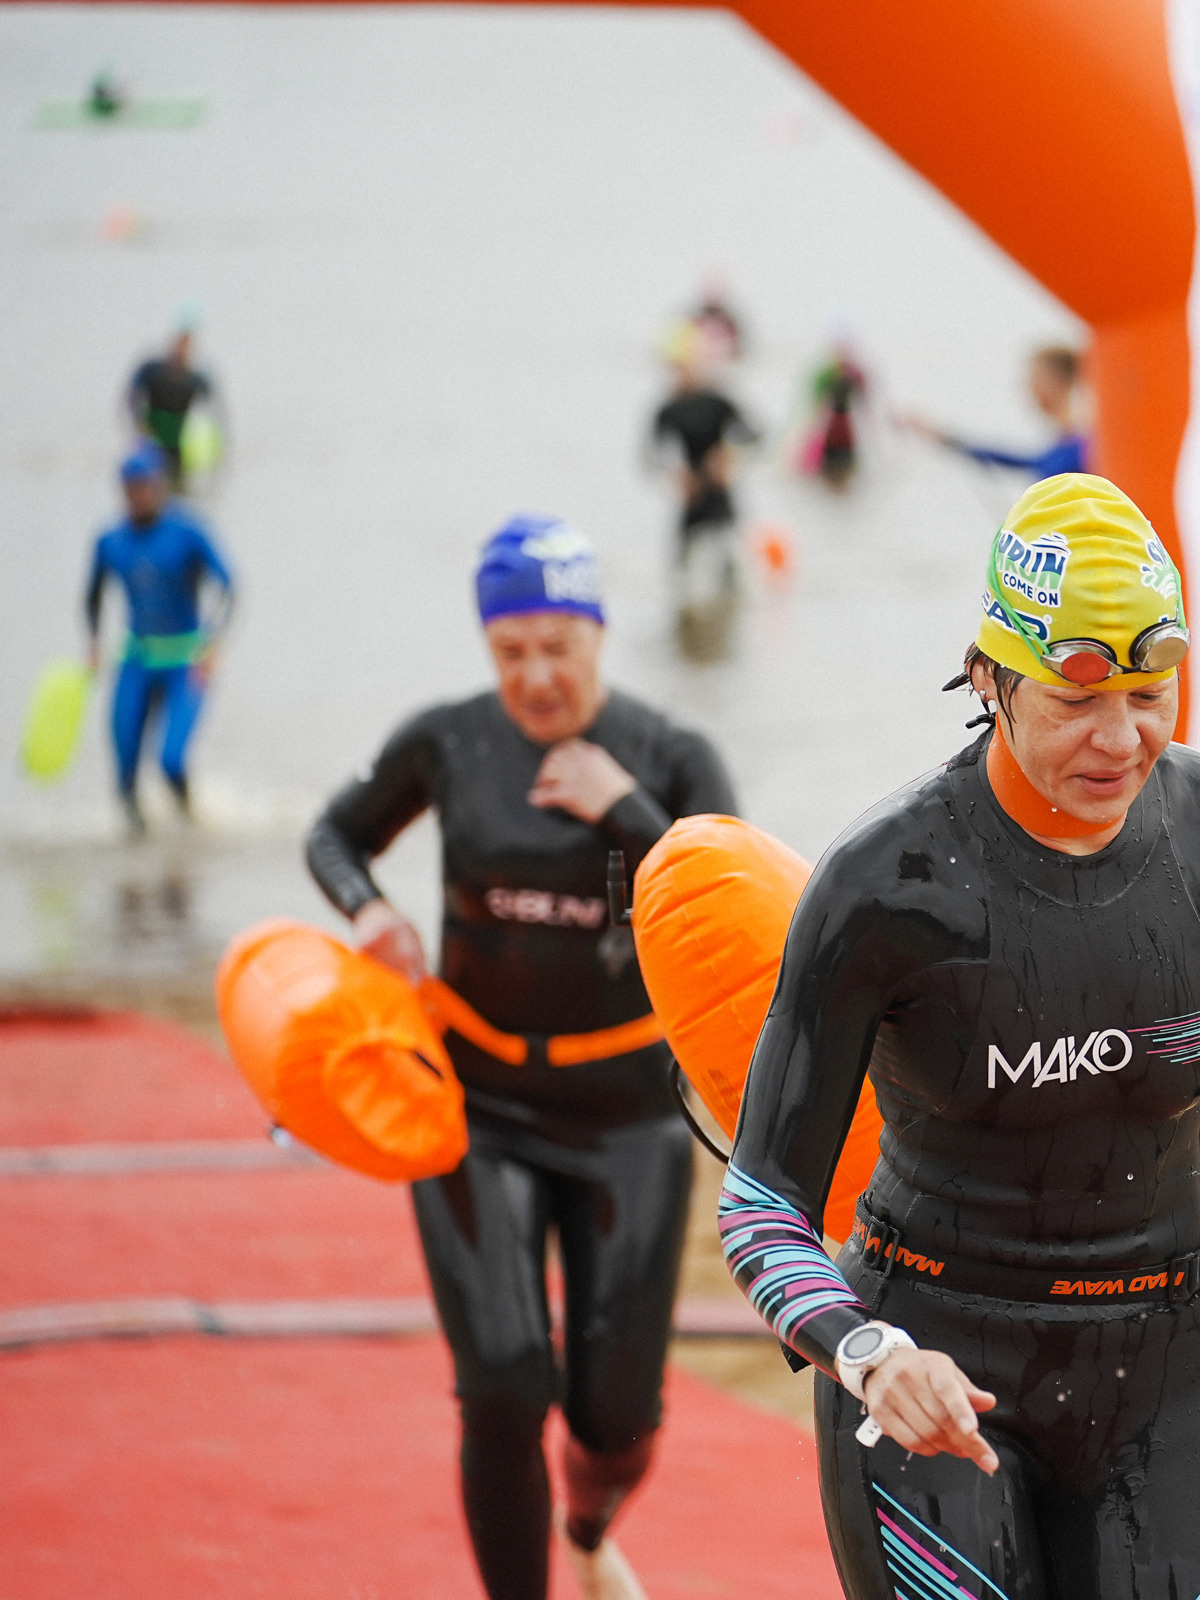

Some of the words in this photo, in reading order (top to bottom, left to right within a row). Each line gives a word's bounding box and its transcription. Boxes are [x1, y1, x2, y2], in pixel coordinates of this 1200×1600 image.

[1002, 573, 1033, 599] COME
[1037, 591, 1059, 606] ON
[987, 1028, 1133, 1089] MAKO
[1050, 1279, 1125, 1296] WAVE
